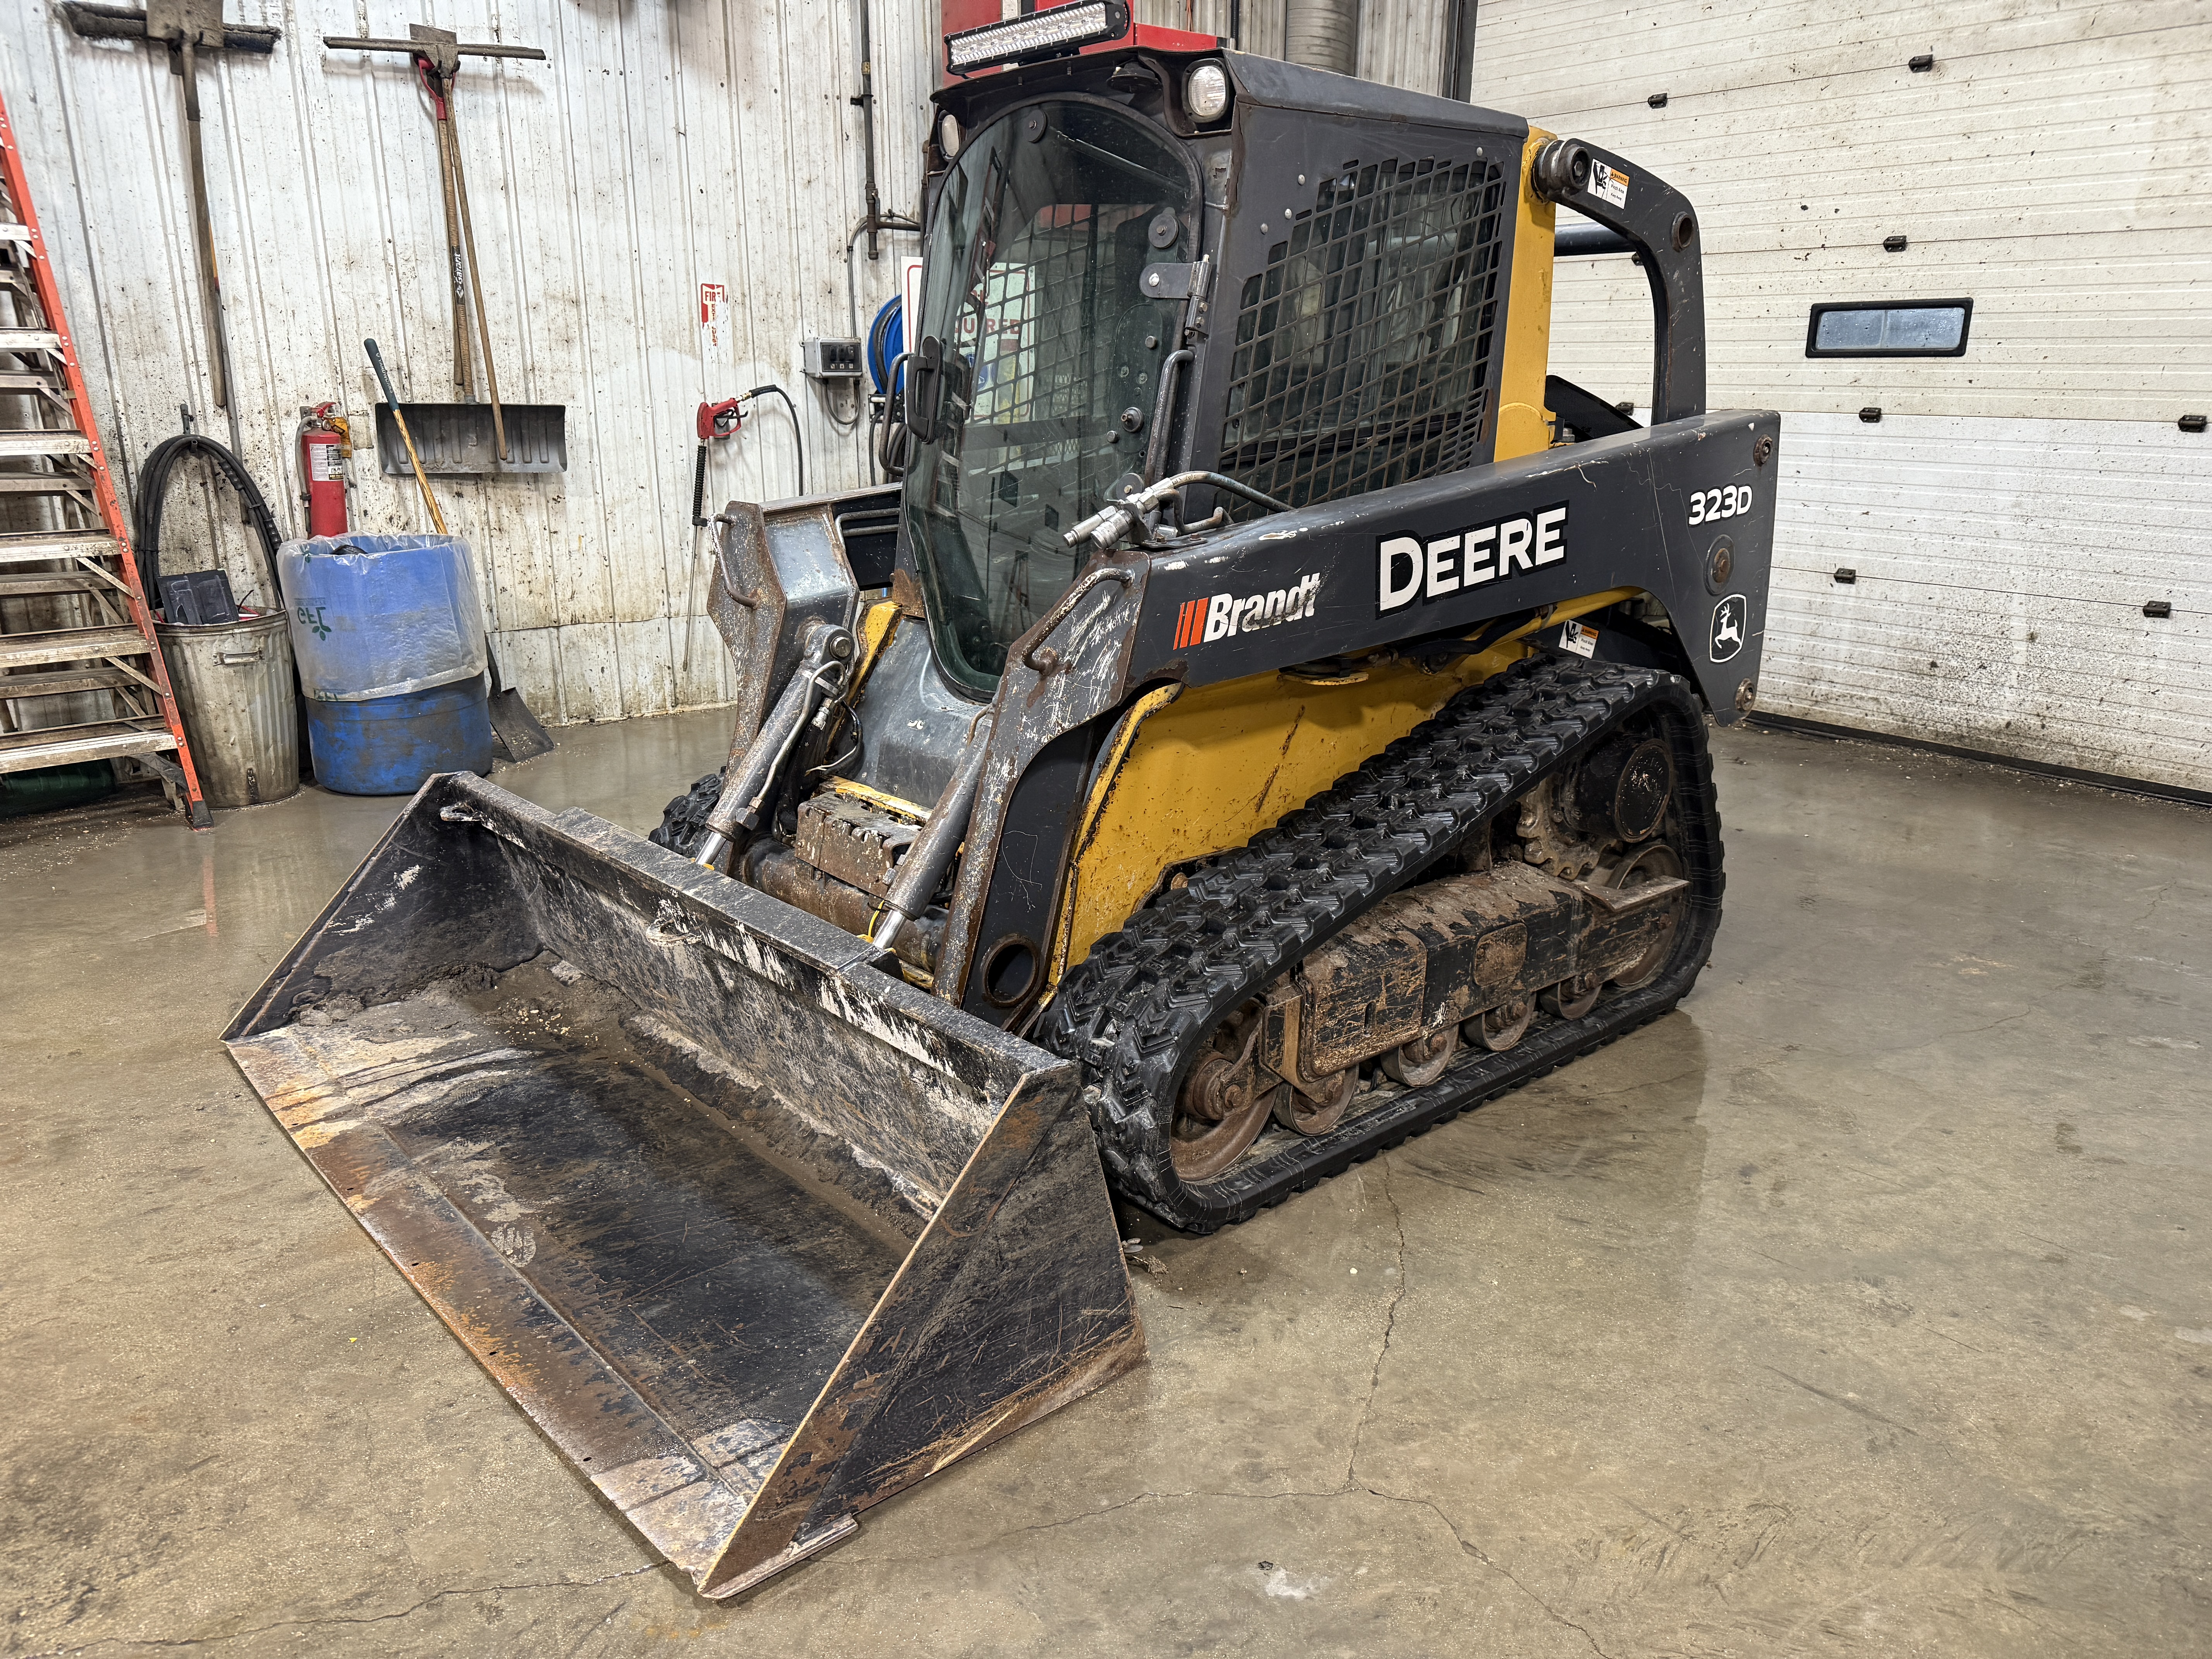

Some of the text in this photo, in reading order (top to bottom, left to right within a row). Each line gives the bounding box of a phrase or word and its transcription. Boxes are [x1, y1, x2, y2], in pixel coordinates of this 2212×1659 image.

[454, 252, 463, 285] Garant
[705, 291, 721, 302] FIR
[378, 359, 393, 393] YARDWORKS
[1689, 485, 1752, 525] 323D
[1380, 507, 1566, 611] DEERE
[1203, 572, 1321, 643] Brandt
